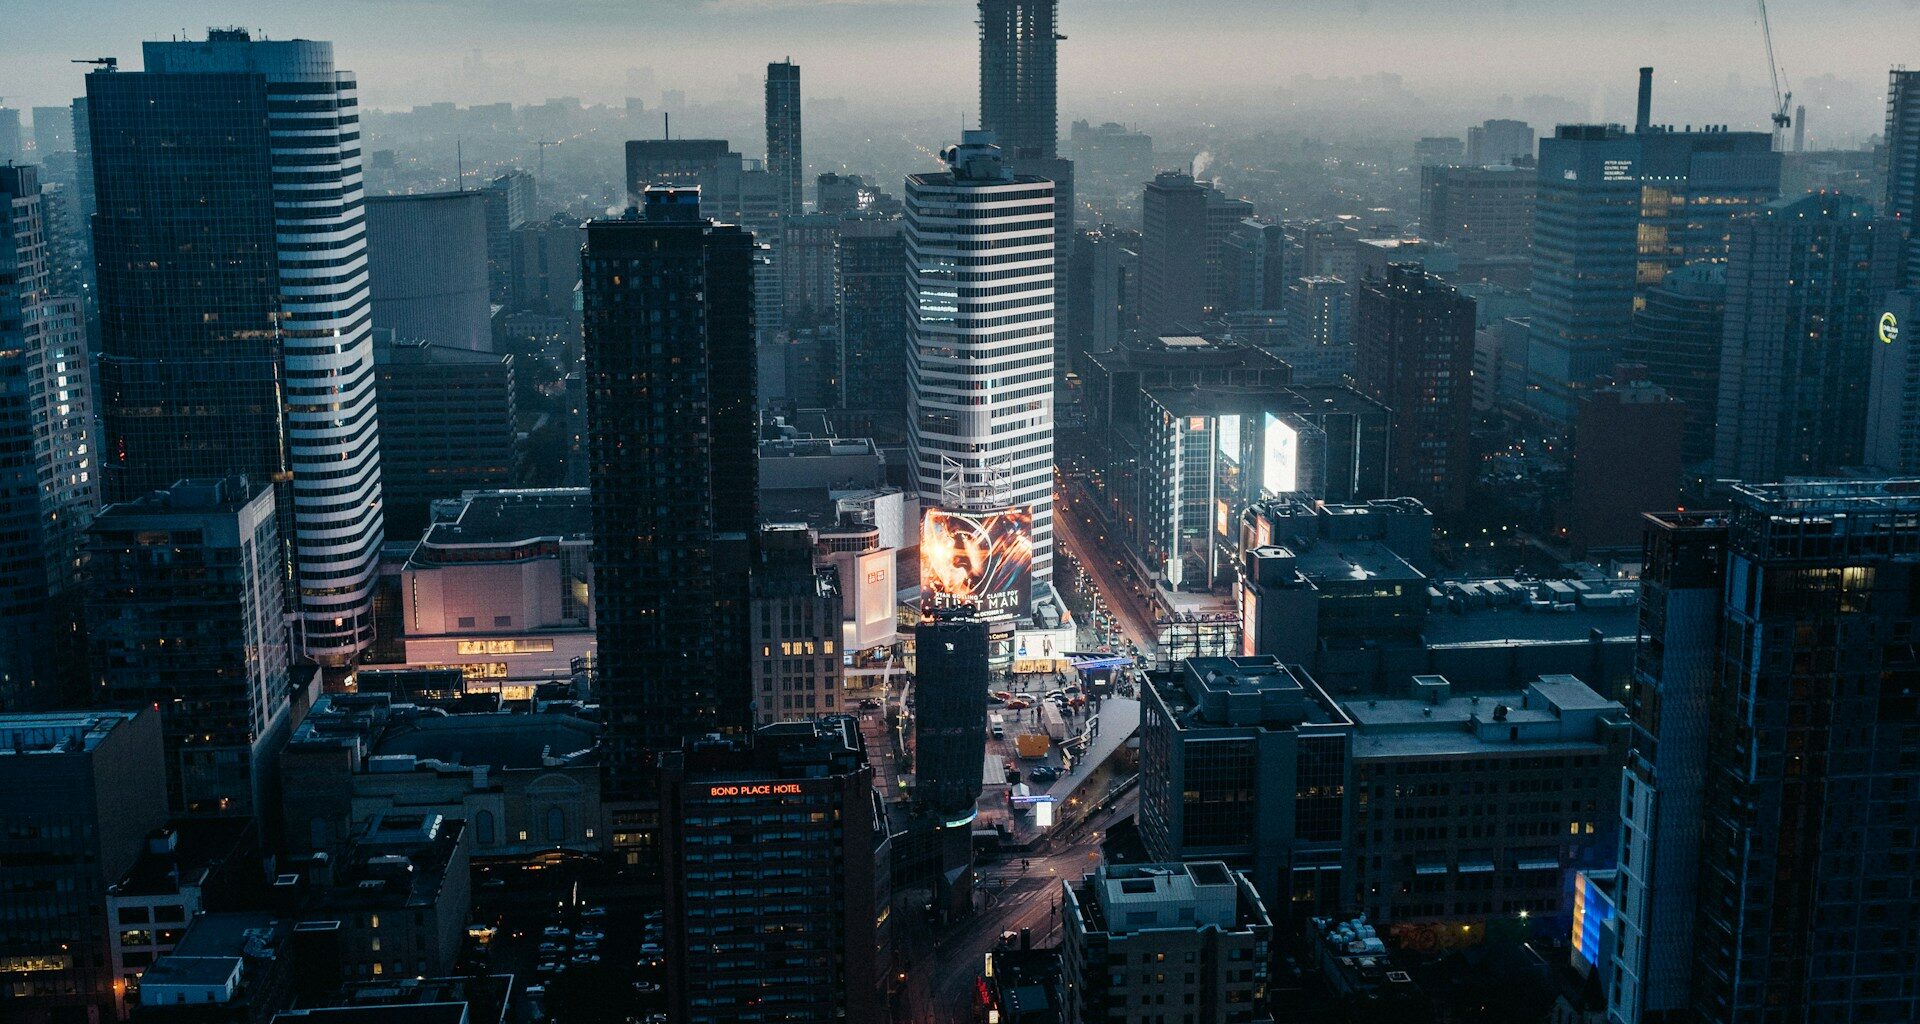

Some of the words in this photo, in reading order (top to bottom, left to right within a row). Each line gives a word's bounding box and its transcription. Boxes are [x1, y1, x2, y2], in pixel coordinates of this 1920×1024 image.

[987, 592, 1006, 600] CLAIRE
[989, 595, 1018, 609] MAN
[711, 787, 738, 796] BOND
[741, 785, 770, 795] PLACE
[773, 784, 801, 794] HOTEL
